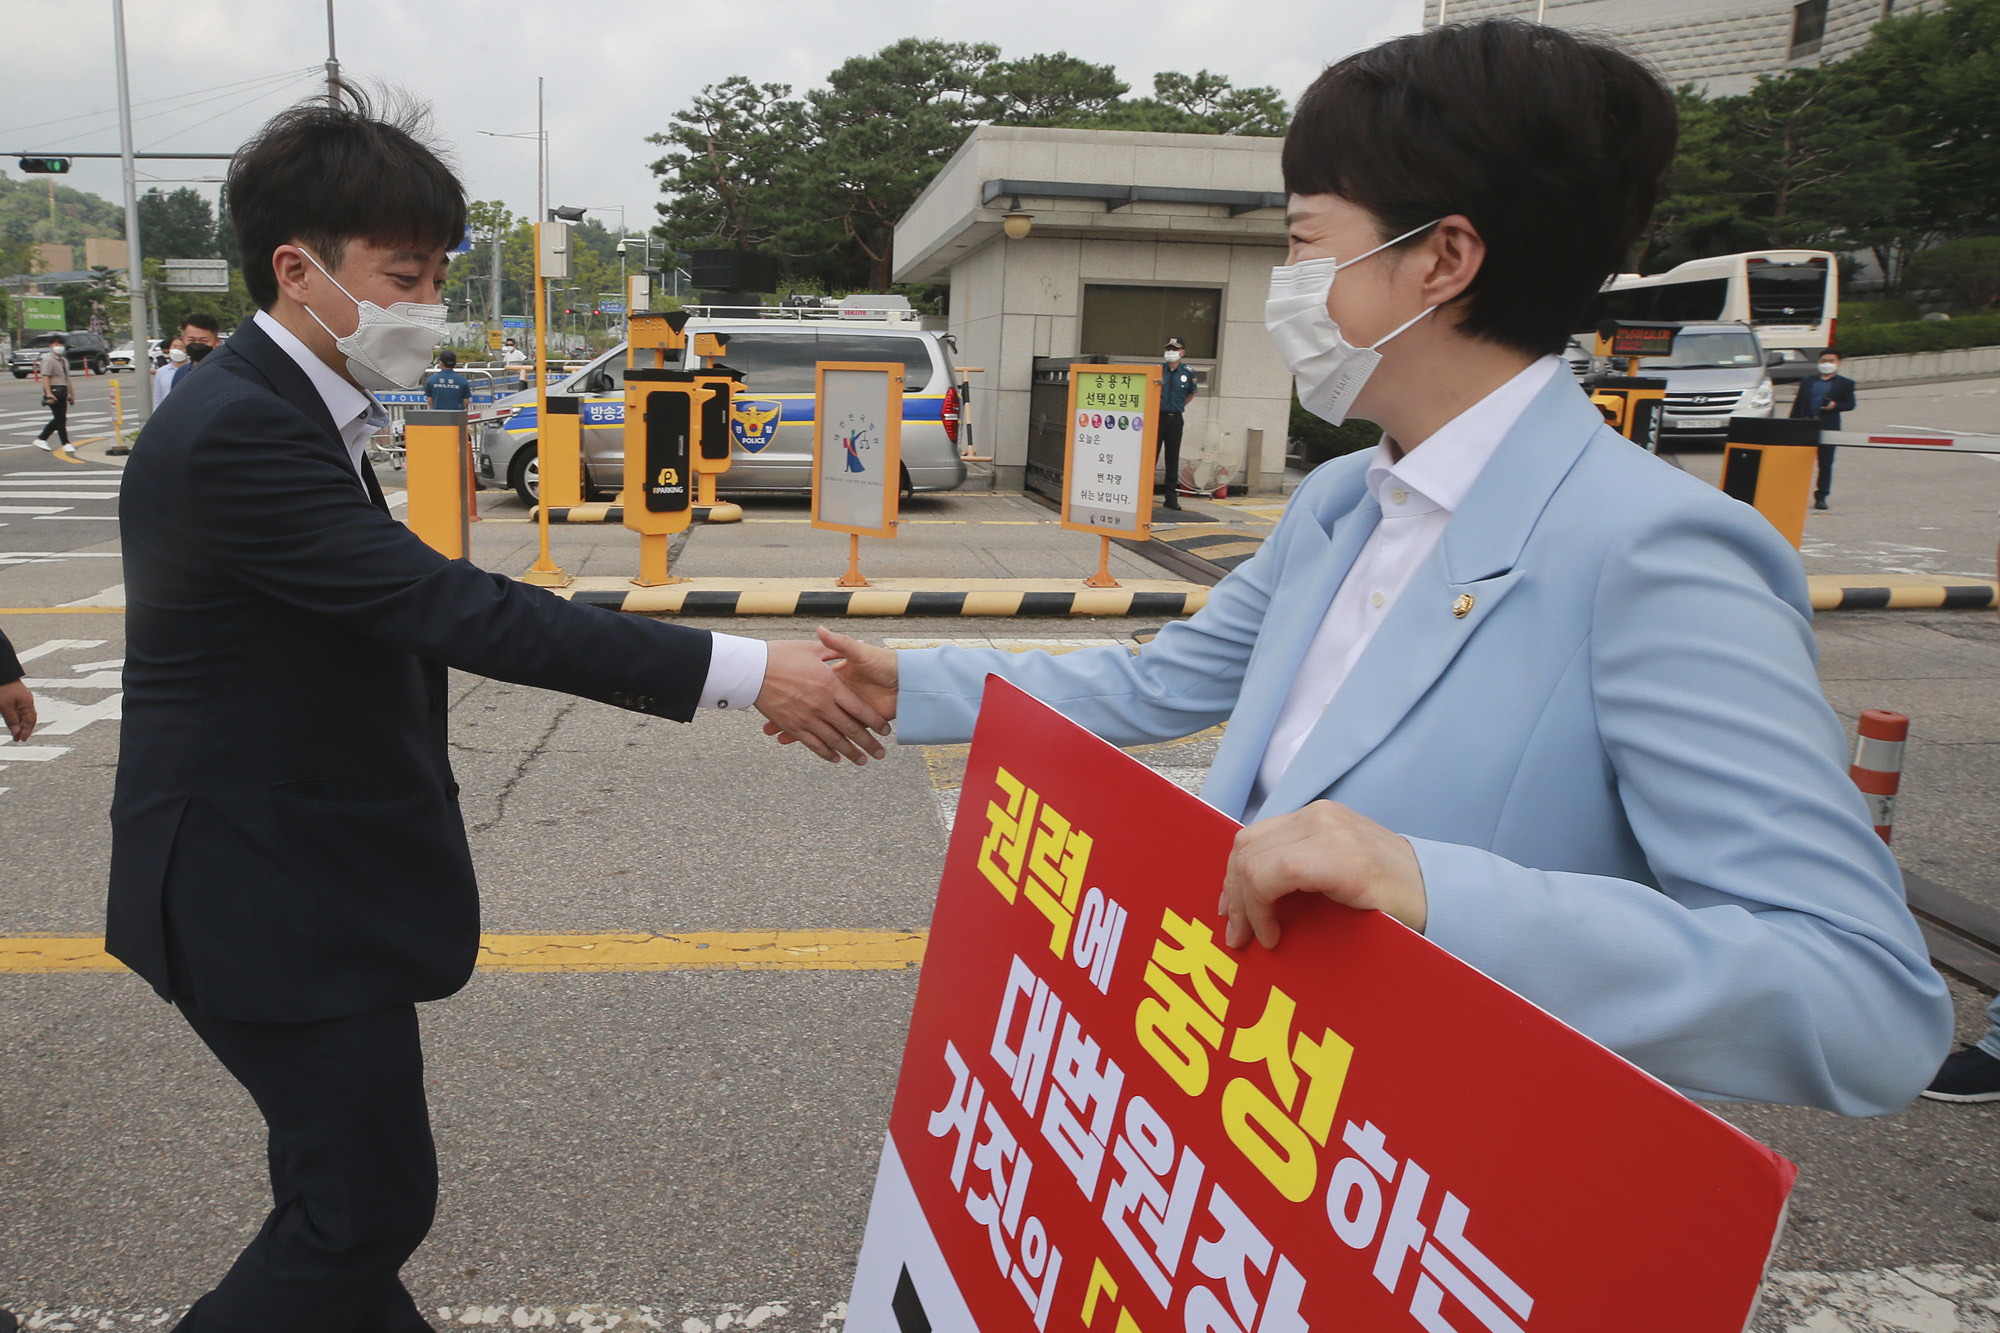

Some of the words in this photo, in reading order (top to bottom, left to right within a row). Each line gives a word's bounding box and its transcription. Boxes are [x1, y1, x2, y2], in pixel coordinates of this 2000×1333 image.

[1095, 374, 1132, 389] 승용차
[391, 394, 428, 402] POLIC
[1086, 392, 1140, 408] 선택요일제
[1078, 433, 1101, 445] 오늘은
[1098, 453, 1113, 464] 요일
[1080, 490, 1095, 500] 쉬는
[977, 766, 1128, 996] 권력에
[1135, 907, 1535, 1333] 충성하는
[990, 953, 1310, 1333] 대법원장
[927, 1039, 1063, 1333] 거짓의
